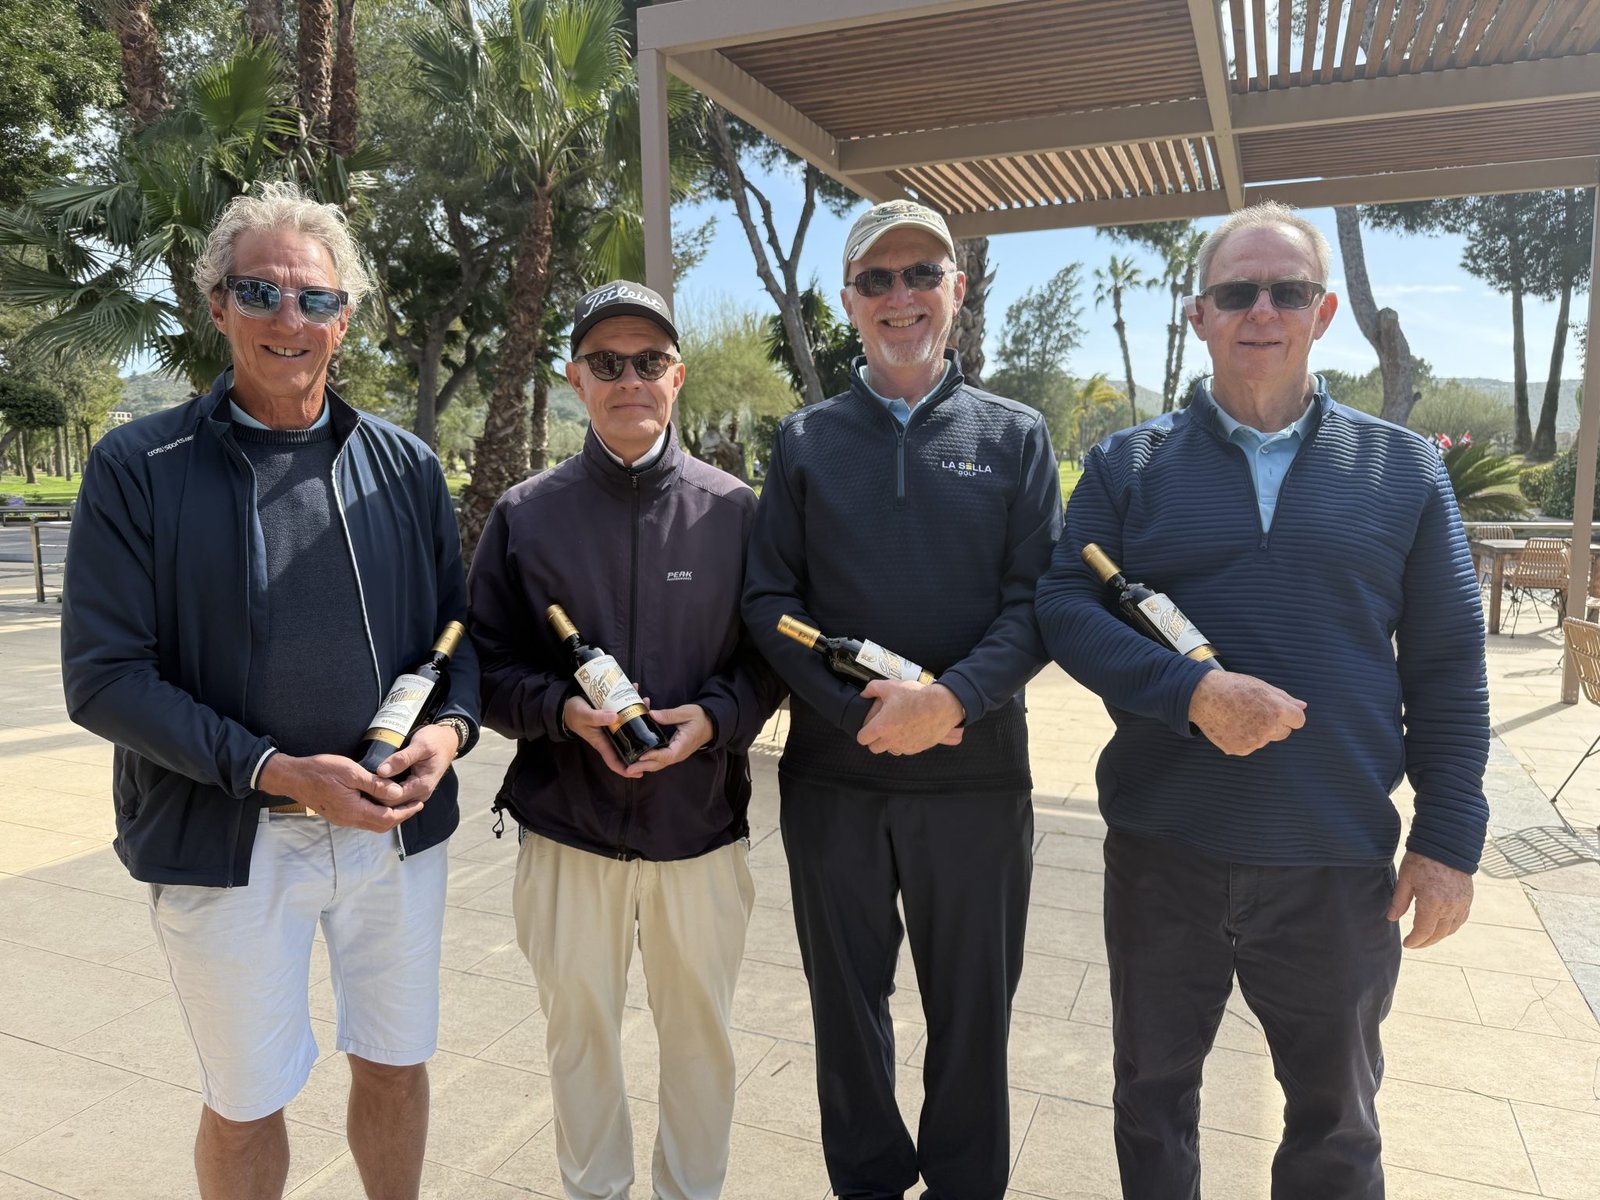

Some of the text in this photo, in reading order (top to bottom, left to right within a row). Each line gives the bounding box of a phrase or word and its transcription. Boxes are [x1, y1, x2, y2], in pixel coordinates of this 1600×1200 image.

[582, 285, 662, 318] Titleist
[941, 460, 993, 474] LA SELLA
[667, 570, 693, 579] PEAK
